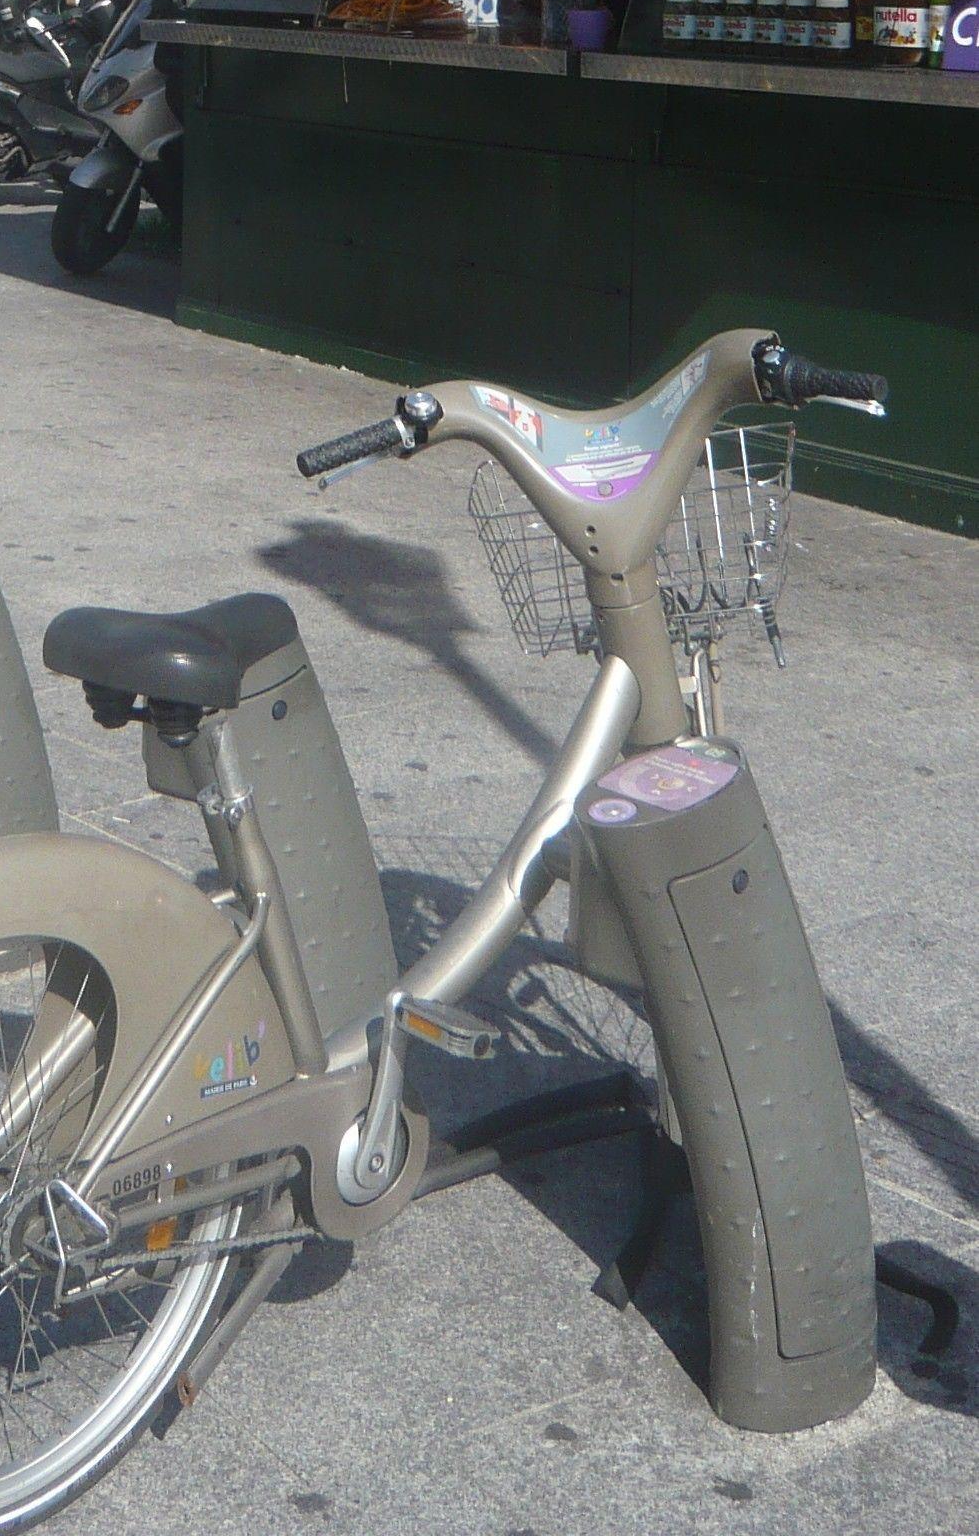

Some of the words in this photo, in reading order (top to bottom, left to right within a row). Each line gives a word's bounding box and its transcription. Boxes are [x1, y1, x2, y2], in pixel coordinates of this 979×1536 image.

[875, 7, 918, 23] nutella
[952, 6, 979, 47] C
[113, 1165, 161, 1196] 06898
